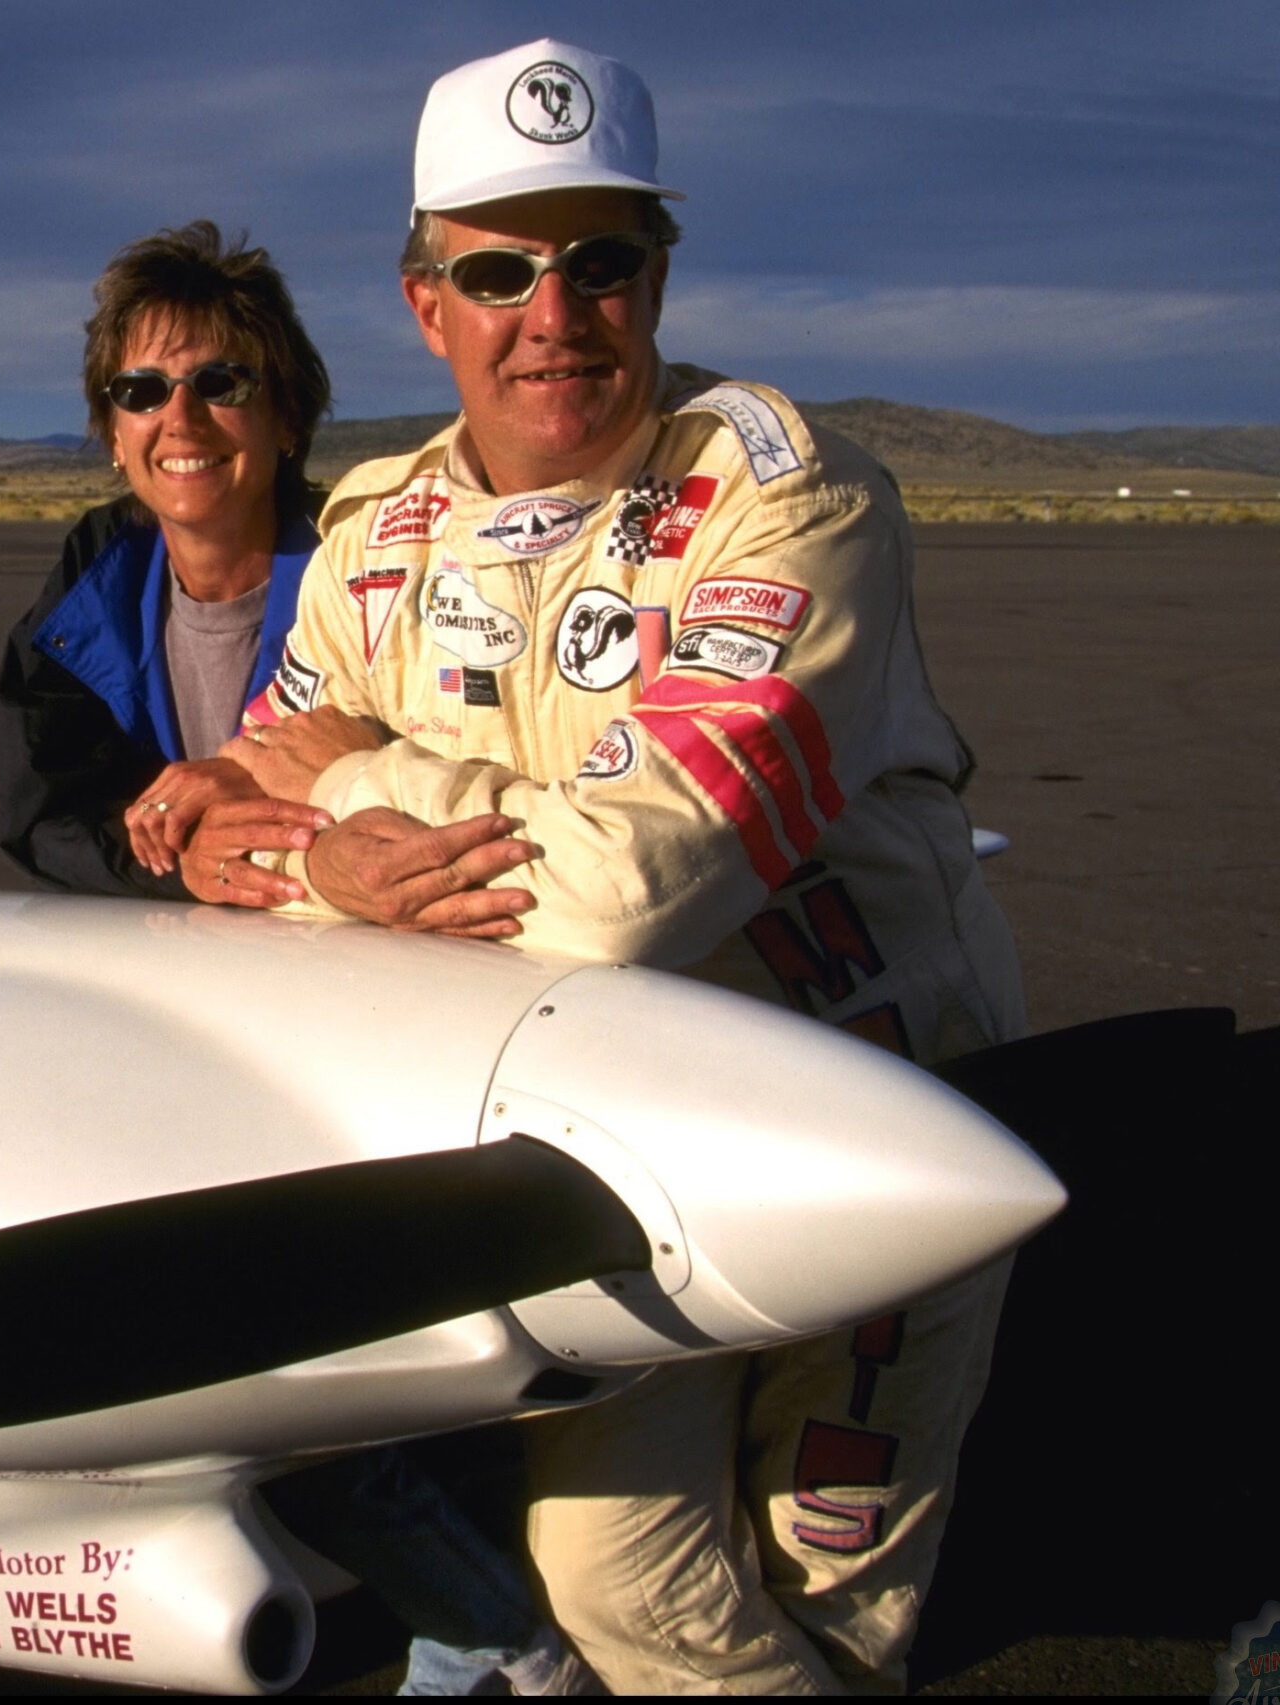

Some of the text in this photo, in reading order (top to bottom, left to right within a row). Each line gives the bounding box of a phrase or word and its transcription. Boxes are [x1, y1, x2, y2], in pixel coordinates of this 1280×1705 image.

[500, 503, 536, 525] AIRCRAFT
[538, 502, 573, 514] SPRUCE
[524, 528, 572, 550] SPECIALTY
[695, 586, 787, 611] SIMPSON
[693, 605, 780, 617] RACE PRODUCTS
[483, 630, 515, 647] INC
[81, 1541, 135, 1582] By:
[6, 1591, 118, 1625] WELLS
[11, 1625, 135, 1662] BLYTHE
